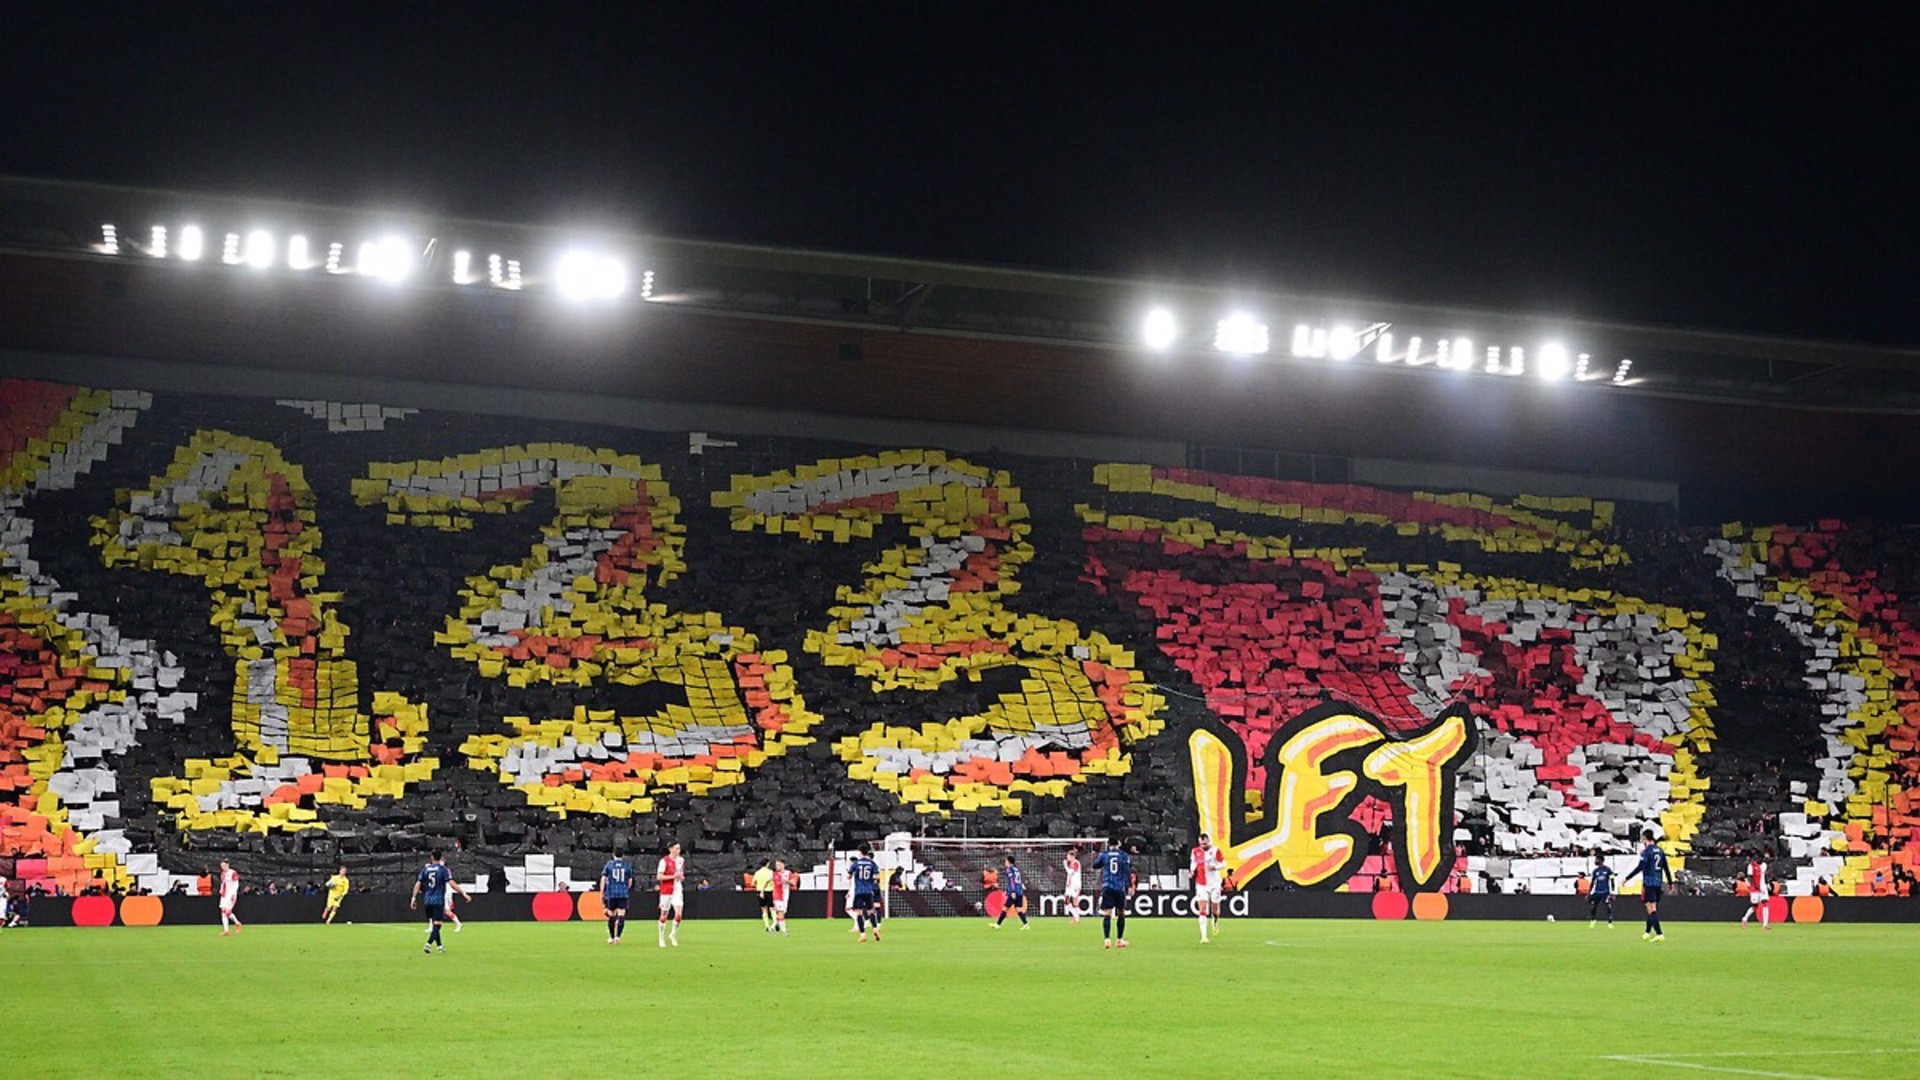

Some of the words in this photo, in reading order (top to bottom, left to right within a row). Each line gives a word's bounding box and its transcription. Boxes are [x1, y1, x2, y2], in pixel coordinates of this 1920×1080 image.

[89, 427, 1168, 832] 133
[1188, 714, 1467, 891] LET
[1109, 857, 1118, 874] 6
[1654, 854, 1662, 870] 2
[428, 871, 436, 889] 5
[612, 868, 625, 882] 41
[858, 865, 871, 880] 16
